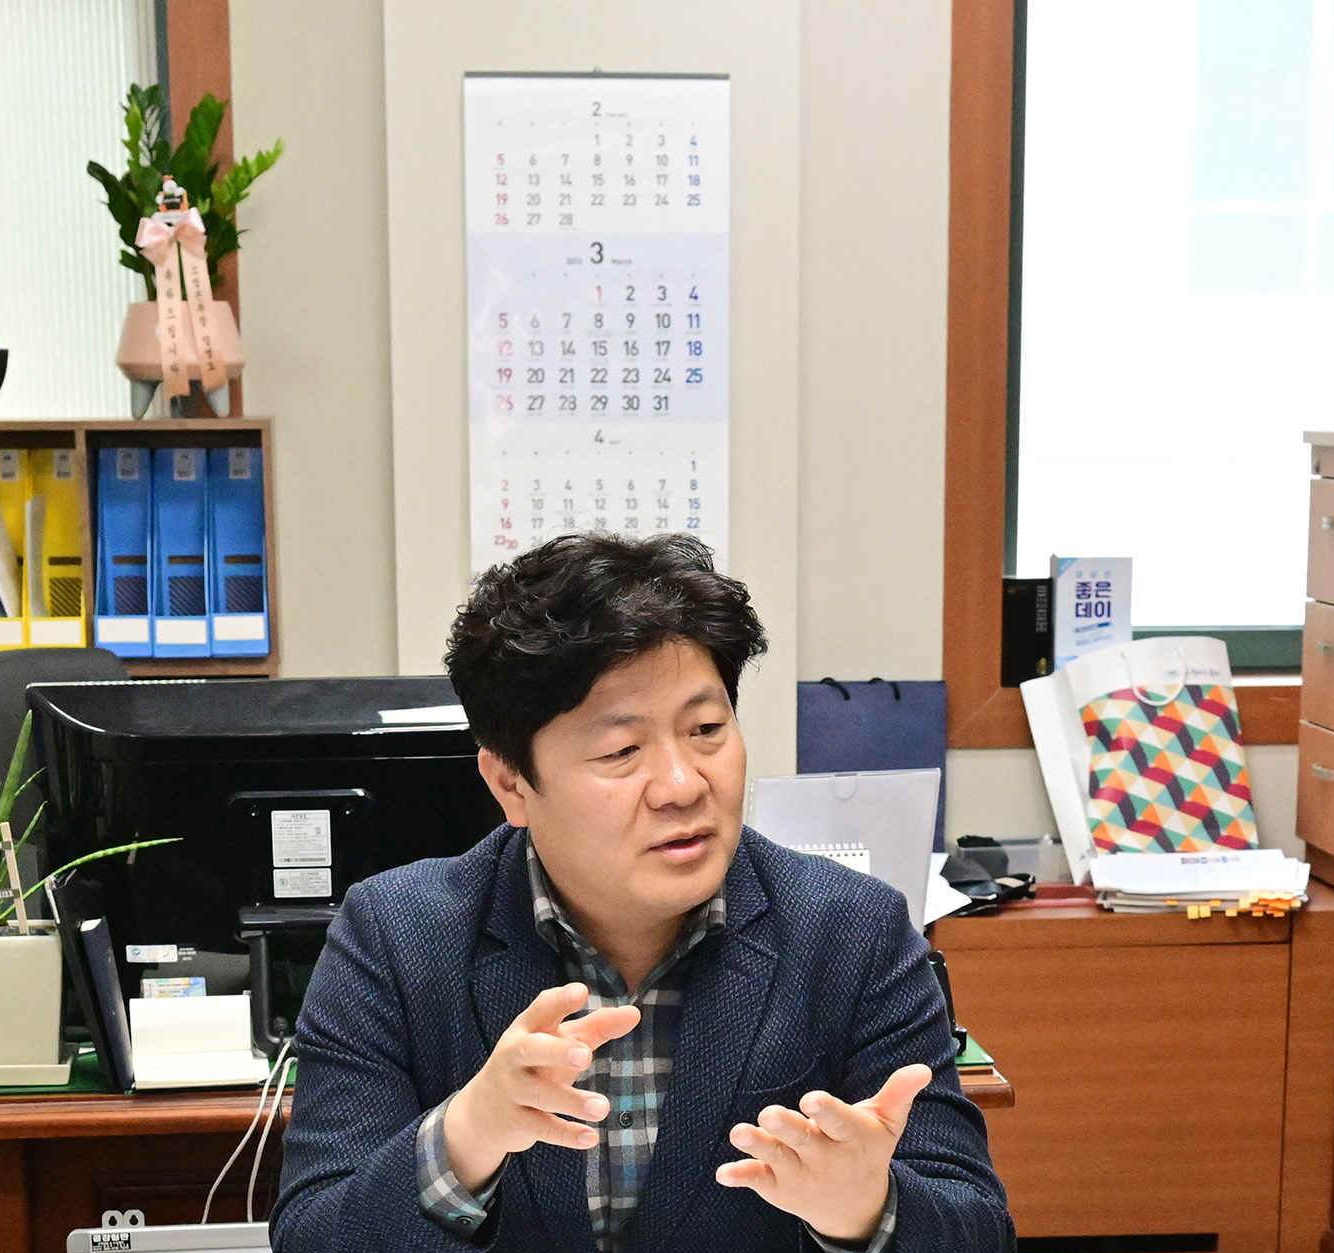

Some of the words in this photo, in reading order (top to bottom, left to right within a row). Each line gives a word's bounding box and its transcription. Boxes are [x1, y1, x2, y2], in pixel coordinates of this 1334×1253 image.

[590, 241, 603, 264] 3
[595, 284, 602, 301] 1
[625, 284, 635, 301] 2
[657, 284, 667, 301] 3
[689, 285, 698, 300] 4
[498, 312, 508, 328] 5
[529, 312, 540, 329] 6
[561, 312, 571, 329] 7
[594, 312, 603, 328] 8
[625, 312, 635, 328] 9
[654, 312, 671, 329] 10
[686, 312, 700, 328] 11
[498, 339, 512, 356] 12
[527, 339, 544, 356] 13
[560, 339, 576, 356] 14
[591, 339, 607, 356] 15
[622, 340, 639, 356] 16
[654, 339, 670, 356] 17
[686, 340, 702, 356] 18
[496, 367, 512, 382] 19
[526, 367, 545, 383] 20
[558, 367, 574, 383] 21
[590, 367, 608, 383] 22
[621, 367, 640, 383] 23
[653, 367, 671, 383] 24
[685, 367, 703, 383] 25
[495, 394, 513, 411] 26
[527, 394, 545, 411] 27
[559, 394, 577, 411] 28
[590, 394, 608, 411] 29
[622, 394, 640, 411] 30
[653, 394, 668, 410] 31
[1076, 581, 1112, 600] 좋은
[1075, 601, 1111, 618] 데이
